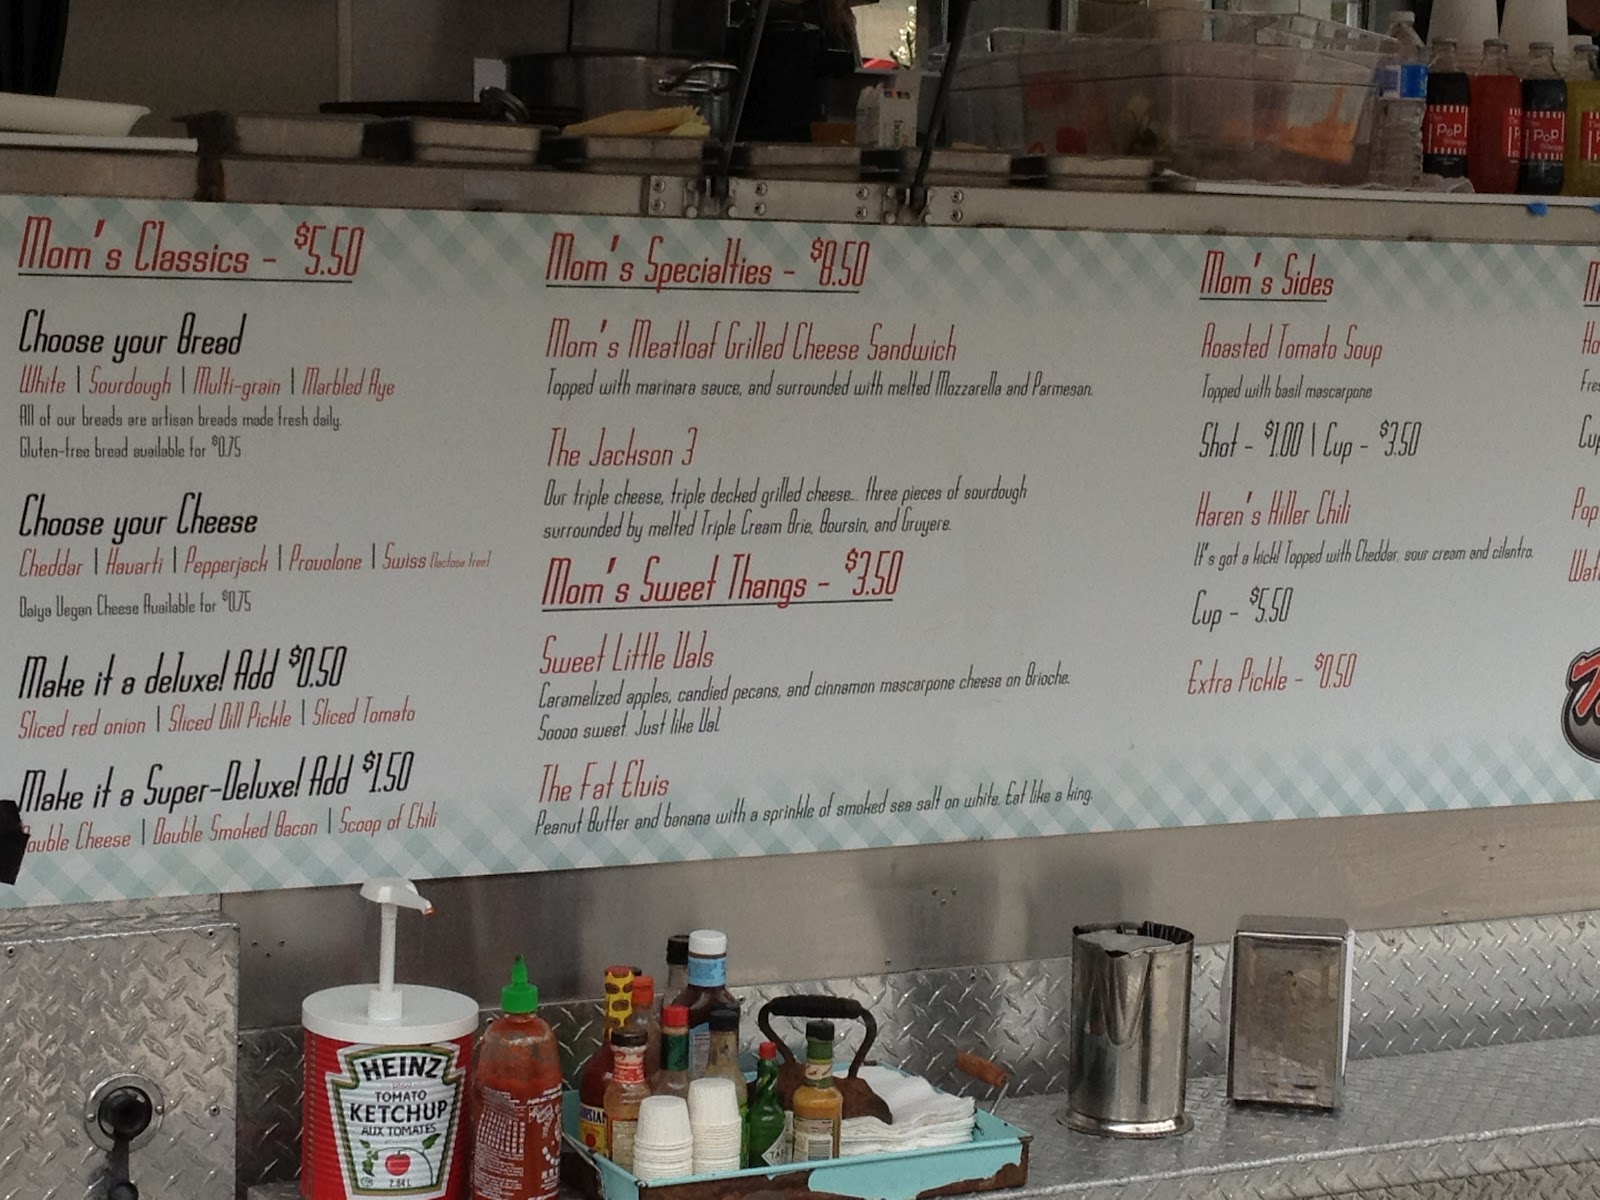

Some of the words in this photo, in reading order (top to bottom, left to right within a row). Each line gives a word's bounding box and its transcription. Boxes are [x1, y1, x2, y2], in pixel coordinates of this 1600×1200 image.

[19, 217, 122, 270] Mom's
[135, 221, 249, 273] Classics
[295, 222, 364, 276] $5.50
[545, 233, 634, 282] Mom's
[640, 235, 772, 293] Specialties
[810, 238, 870, 286] $8.50
[1199, 250, 1274, 296] Mom's
[1281, 252, 1335, 297] Sides
[19, 310, 104, 353] Choose
[112, 335, 168, 363] your
[177, 312, 247, 354] Bread
[546, 318, 619, 358] Mom's
[629, 319, 721, 359] Meatloaf
[725, 321, 789, 359] Grilled
[793, 322, 859, 360] Cheese
[867, 322, 957, 361] Sandwich
[1201, 323, 1273, 358] Roasted
[1278, 323, 1337, 359] Tomato
[1344, 324, 1382, 367] Soup
[19, 365, 66, 393] White
[89, 365, 171, 398] Sourdough
[193, 367, 281, 400] Multi-grain
[302, 368, 366, 395] Marbled
[547, 368, 597, 401] Topped
[636, 381, 696, 395] marinara
[776, 370, 852, 395] surrounded
[888, 370, 933, 396] melted
[935, 371, 1002, 396] Mozzarella
[1202, 374, 1243, 403] Topped
[1275, 374, 1304, 398] basil
[1305, 388, 1373, 404] mascarpone
[20, 405, 33, 426] All
[83, 405, 121, 427] breads
[152, 405, 192, 426] artisan
[199, 405, 236, 426] breads
[243, 405, 273, 426] made
[278, 405, 307, 426] fresh
[21, 436, 89, 458] Gluten-free
[96, 436, 127, 457] bread
[134, 436, 184, 458] available
[213, 435, 240, 457] $0.75
[547, 428, 580, 466] The
[589, 428, 673, 465] Jackson
[682, 428, 698, 465] 3
[1199, 423, 1240, 457] Shot
[1265, 420, 1304, 456] $1.00
[1323, 422, 1352, 464] Cup
[1380, 420, 1422, 455] $3.50
[544, 479, 567, 505] Our
[573, 479, 609, 509] triple
[711, 477, 760, 503] decked
[761, 476, 804, 508] grilled
[866, 476, 898, 501] three
[901, 486, 942, 506] pieces
[964, 475, 1027, 505] sourdough
[1317, 490, 1351, 524] Chili
[19, 493, 104, 536] Choose
[112, 516, 167, 545] your
[177, 492, 257, 534] Cheese
[543, 512, 624, 538] surrounded
[648, 510, 697, 536] melted
[702, 510, 736, 541] Triple
[741, 509, 782, 535] Cream
[19, 548, 83, 576] Cheddar
[105, 547, 163, 575] Havarti
[184, 545, 268, 577] Pepperjack
[289, 543, 362, 571] Provolone
[383, 543, 426, 569] Swiss
[1218, 541, 1239, 571] got
[1285, 540, 1325, 569] Topped
[542, 557, 629, 604] Mom's
[640, 555, 719, 602] Sweet
[729, 554, 807, 608] Thangs
[845, 549, 904, 596] $3.50
[57, 595, 91, 621] Vegan
[98, 594, 138, 616] Cheese
[144, 592, 194, 614] Available
[223, 589, 250, 612] $0.75
[1192, 589, 1222, 632] Cup
[1250, 586, 1293, 623] $5.50
[18, 656, 85, 698] Make
[144, 650, 230, 694] deluxe!
[233, 648, 280, 690] Add
[289, 646, 347, 687] $0.50
[539, 633, 607, 674] Sweet
[612, 632, 665, 671] Little
[1188, 659, 1232, 694] Extra
[1239, 657, 1287, 692] Pickle
[1314, 652, 1357, 688] $0.50
[538, 679, 624, 708] Caramelized
[677, 675, 731, 702] candied
[814, 682, 875, 696] cinnamon
[879, 679, 955, 694] mascarpone
[959, 664, 1002, 689] cheese
[18, 710, 69, 738] Sliced
[72, 709, 101, 736] red
[104, 720, 145, 734] onion
[168, 704, 216, 732] Sliced
[219, 702, 244, 729] Dill
[247, 700, 291, 728] Pickle
[312, 698, 359, 725] Sliced
[363, 696, 415, 723] Tomato
[634, 708, 666, 736] Just
[670, 708, 694, 733] like
[17, 768, 83, 812] Make
[144, 756, 306, 812] Super-Deluxe!
[309, 754, 354, 796] Add
[363, 751, 414, 793] $1.50
[539, 764, 571, 802] The
[580, 762, 617, 800] Fat
[622, 760, 669, 797] Elvis
[75, 822, 131, 849] Cheese
[153, 816, 203, 844] Double
[209, 811, 272, 841] Smoked
[274, 810, 318, 837] Bacon
[339, 806, 382, 834] Scoop
[407, 801, 438, 828] Chili
[535, 808, 584, 835] Peanut
[587, 806, 629, 832] Butter
[664, 802, 711, 827] banana
[716, 798, 746, 824] with
[763, 794, 814, 825] sprinkle
[837, 788, 889, 816] smoked
[916, 785, 942, 811] salt
[1005, 781, 1027, 805] Eat
[1030, 780, 1050, 803] like
[360, 1056, 442, 1081] HEINZ
[350, 1100, 448, 1123] KETCHUP
[374, 1090, 427, 1102] TOMATO
[361, 1125, 385, 1136] AUX
[388, 1123, 437, 1136] TOMATES
